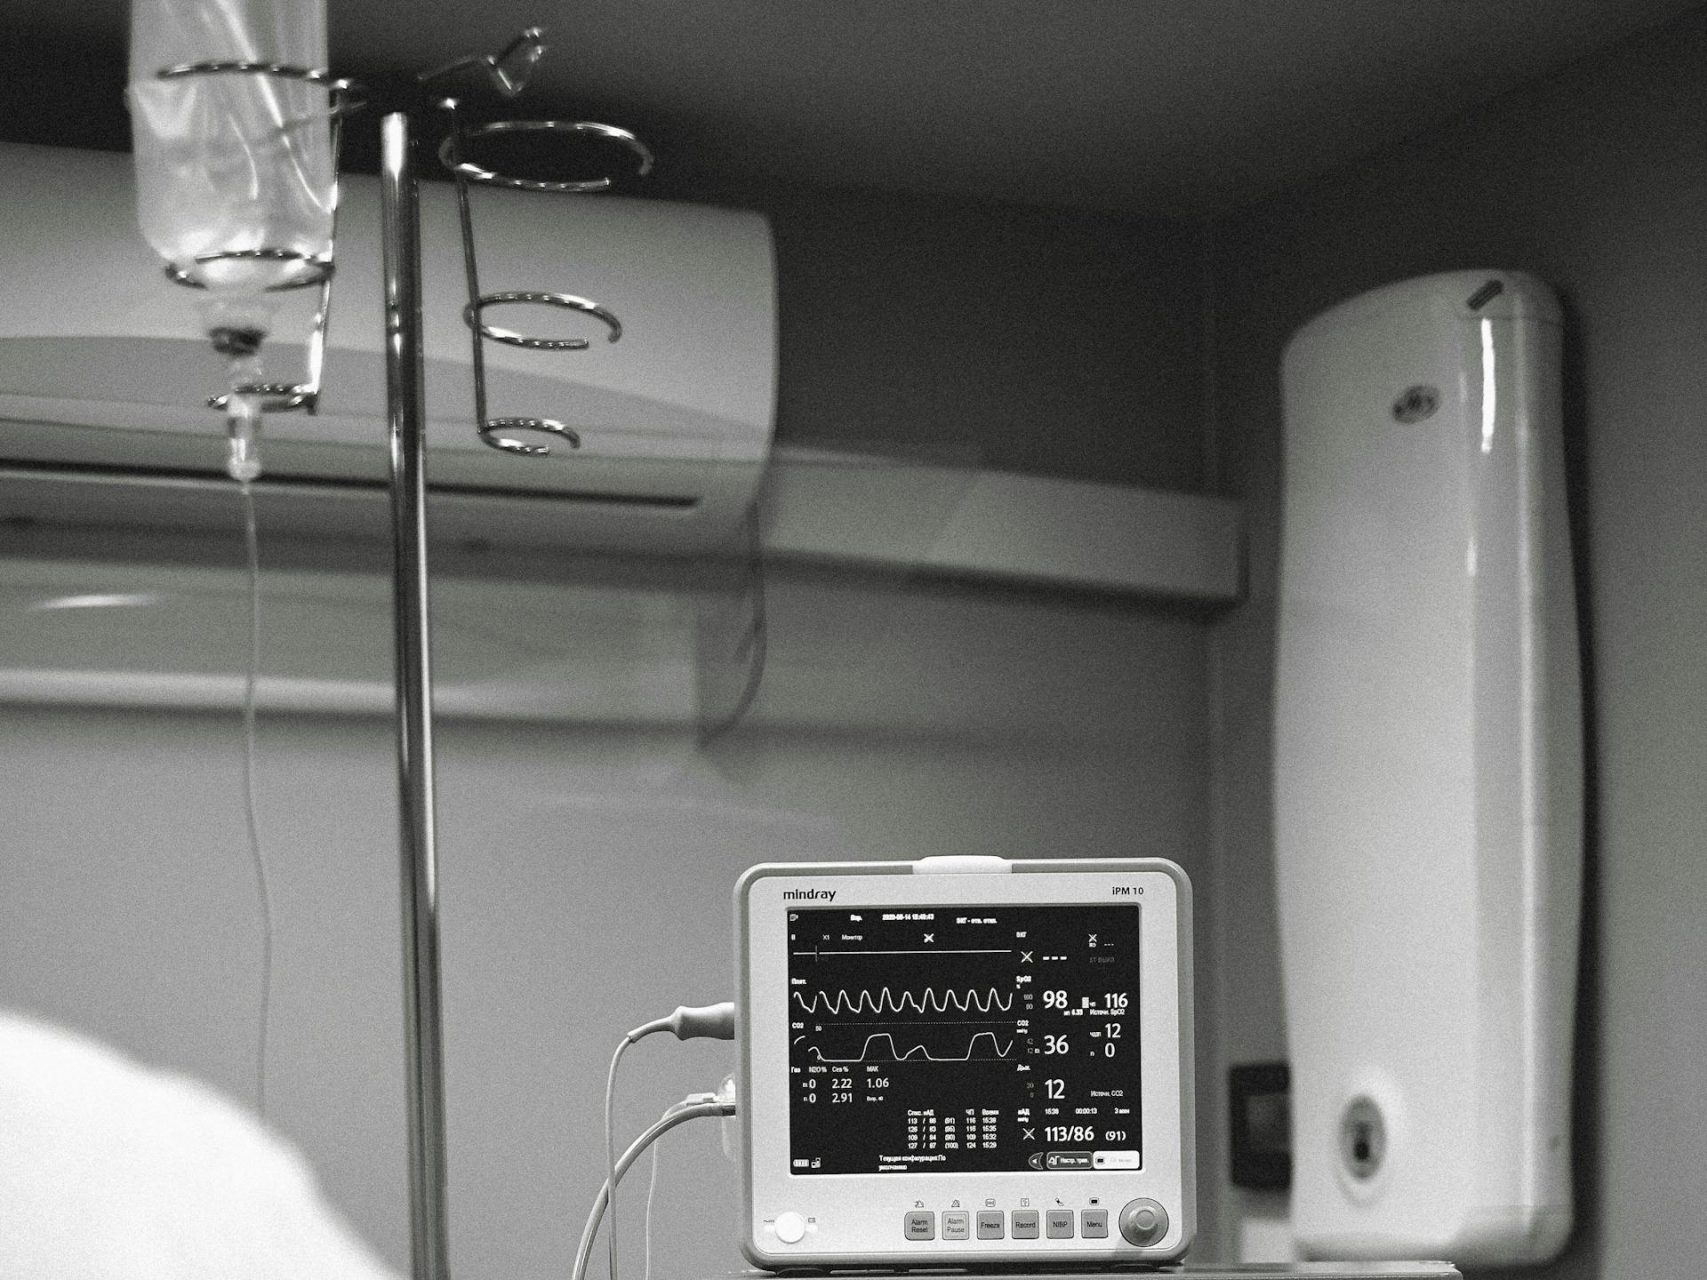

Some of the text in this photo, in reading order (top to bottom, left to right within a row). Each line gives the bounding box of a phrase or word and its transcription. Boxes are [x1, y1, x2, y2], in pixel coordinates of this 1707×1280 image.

[783, 889, 837, 902] mindray
[1112, 887, 1144, 895] iPM 10
[1043, 990, 1068, 1009] 98
[1104, 992, 1128, 1008] 116
[1104, 1023, 1122, 1039] 12
[1043, 1034, 1069, 1055] 36
[1104, 1042, 1116, 1058] 0
[808, 1079, 816, 1089] 0
[831, 1078, 853, 1089] 2.22
[866, 1077, 890, 1089] 1.06
[1044, 1079, 1065, 1099] 12
[809, 1093, 816, 1103] 0
[831, 1092, 853, 1103] 2.91
[907, 1117, 918, 1125] 113
[1044, 1125, 1127, 1142] 113/86 (91)
